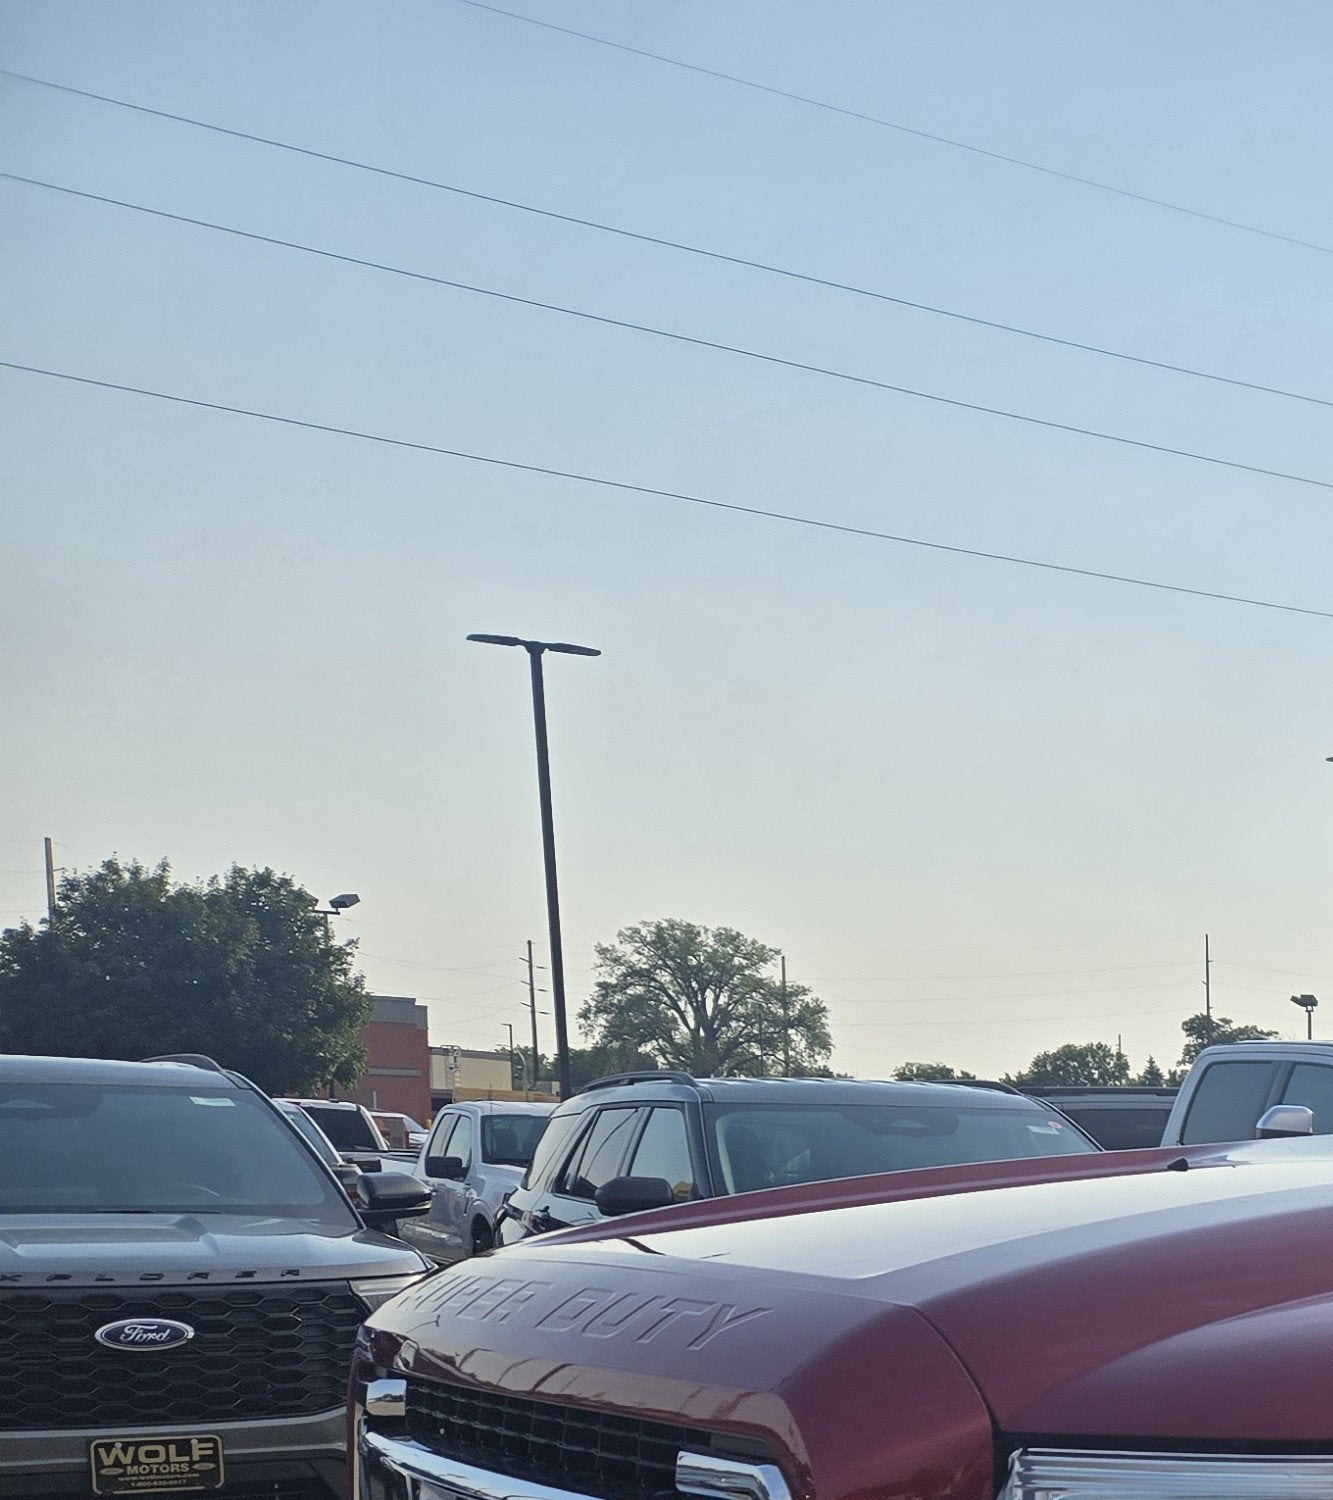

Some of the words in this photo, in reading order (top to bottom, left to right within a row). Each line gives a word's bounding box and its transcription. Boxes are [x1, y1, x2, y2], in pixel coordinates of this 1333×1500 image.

[534, 1286, 774, 1351] DUTY
[119, 1324, 172, 1342] Ford
[98, 1442, 215, 1466] WOLF
[126, 1463, 190, 1475] MOTORS
